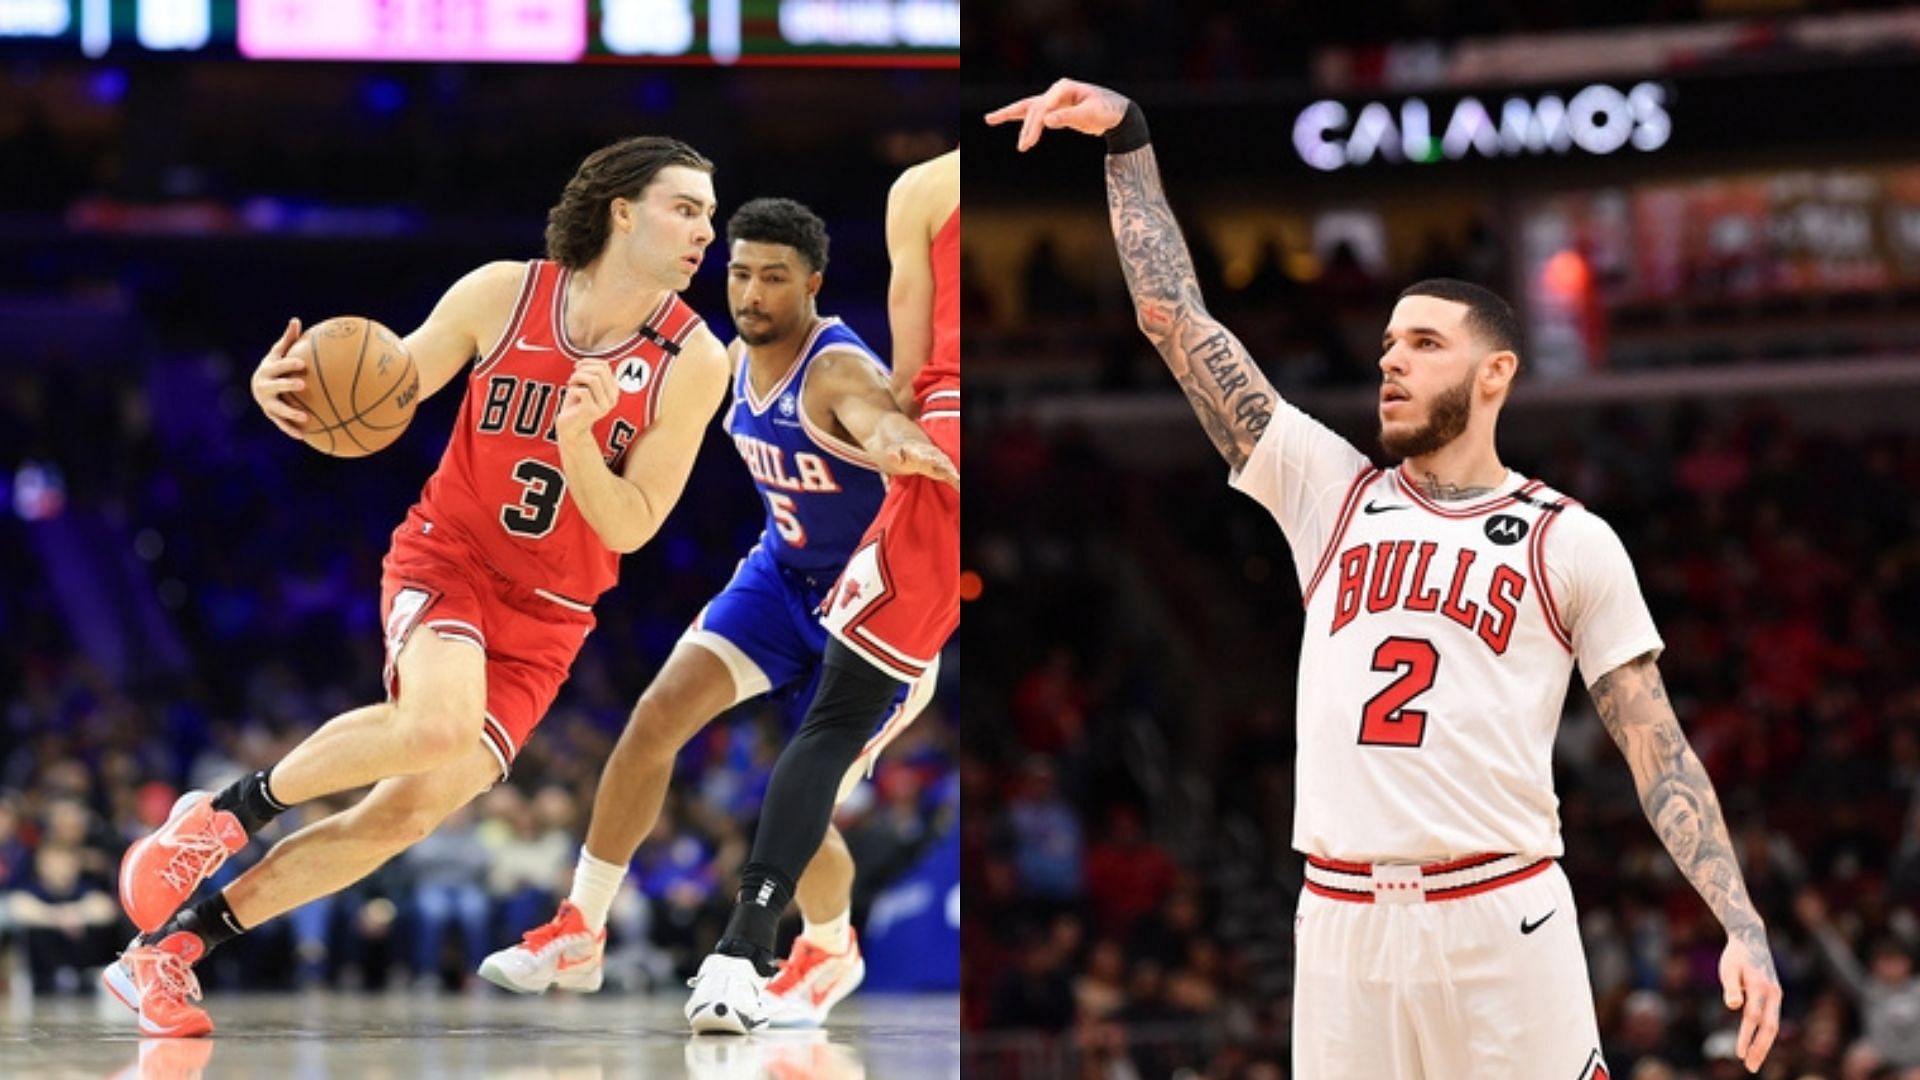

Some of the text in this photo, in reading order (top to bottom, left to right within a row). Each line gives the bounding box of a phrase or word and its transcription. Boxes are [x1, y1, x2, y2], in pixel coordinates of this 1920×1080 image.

[1293, 82, 1671, 170] CALAMOS
[1190, 332, 1248, 405] FEAR
[477, 375, 637, 474] BUS
[500, 457, 566, 540] 3
[765, 490, 808, 549] 5
[1328, 539, 1527, 656] BULLS
[1356, 635, 1441, 748] 2
